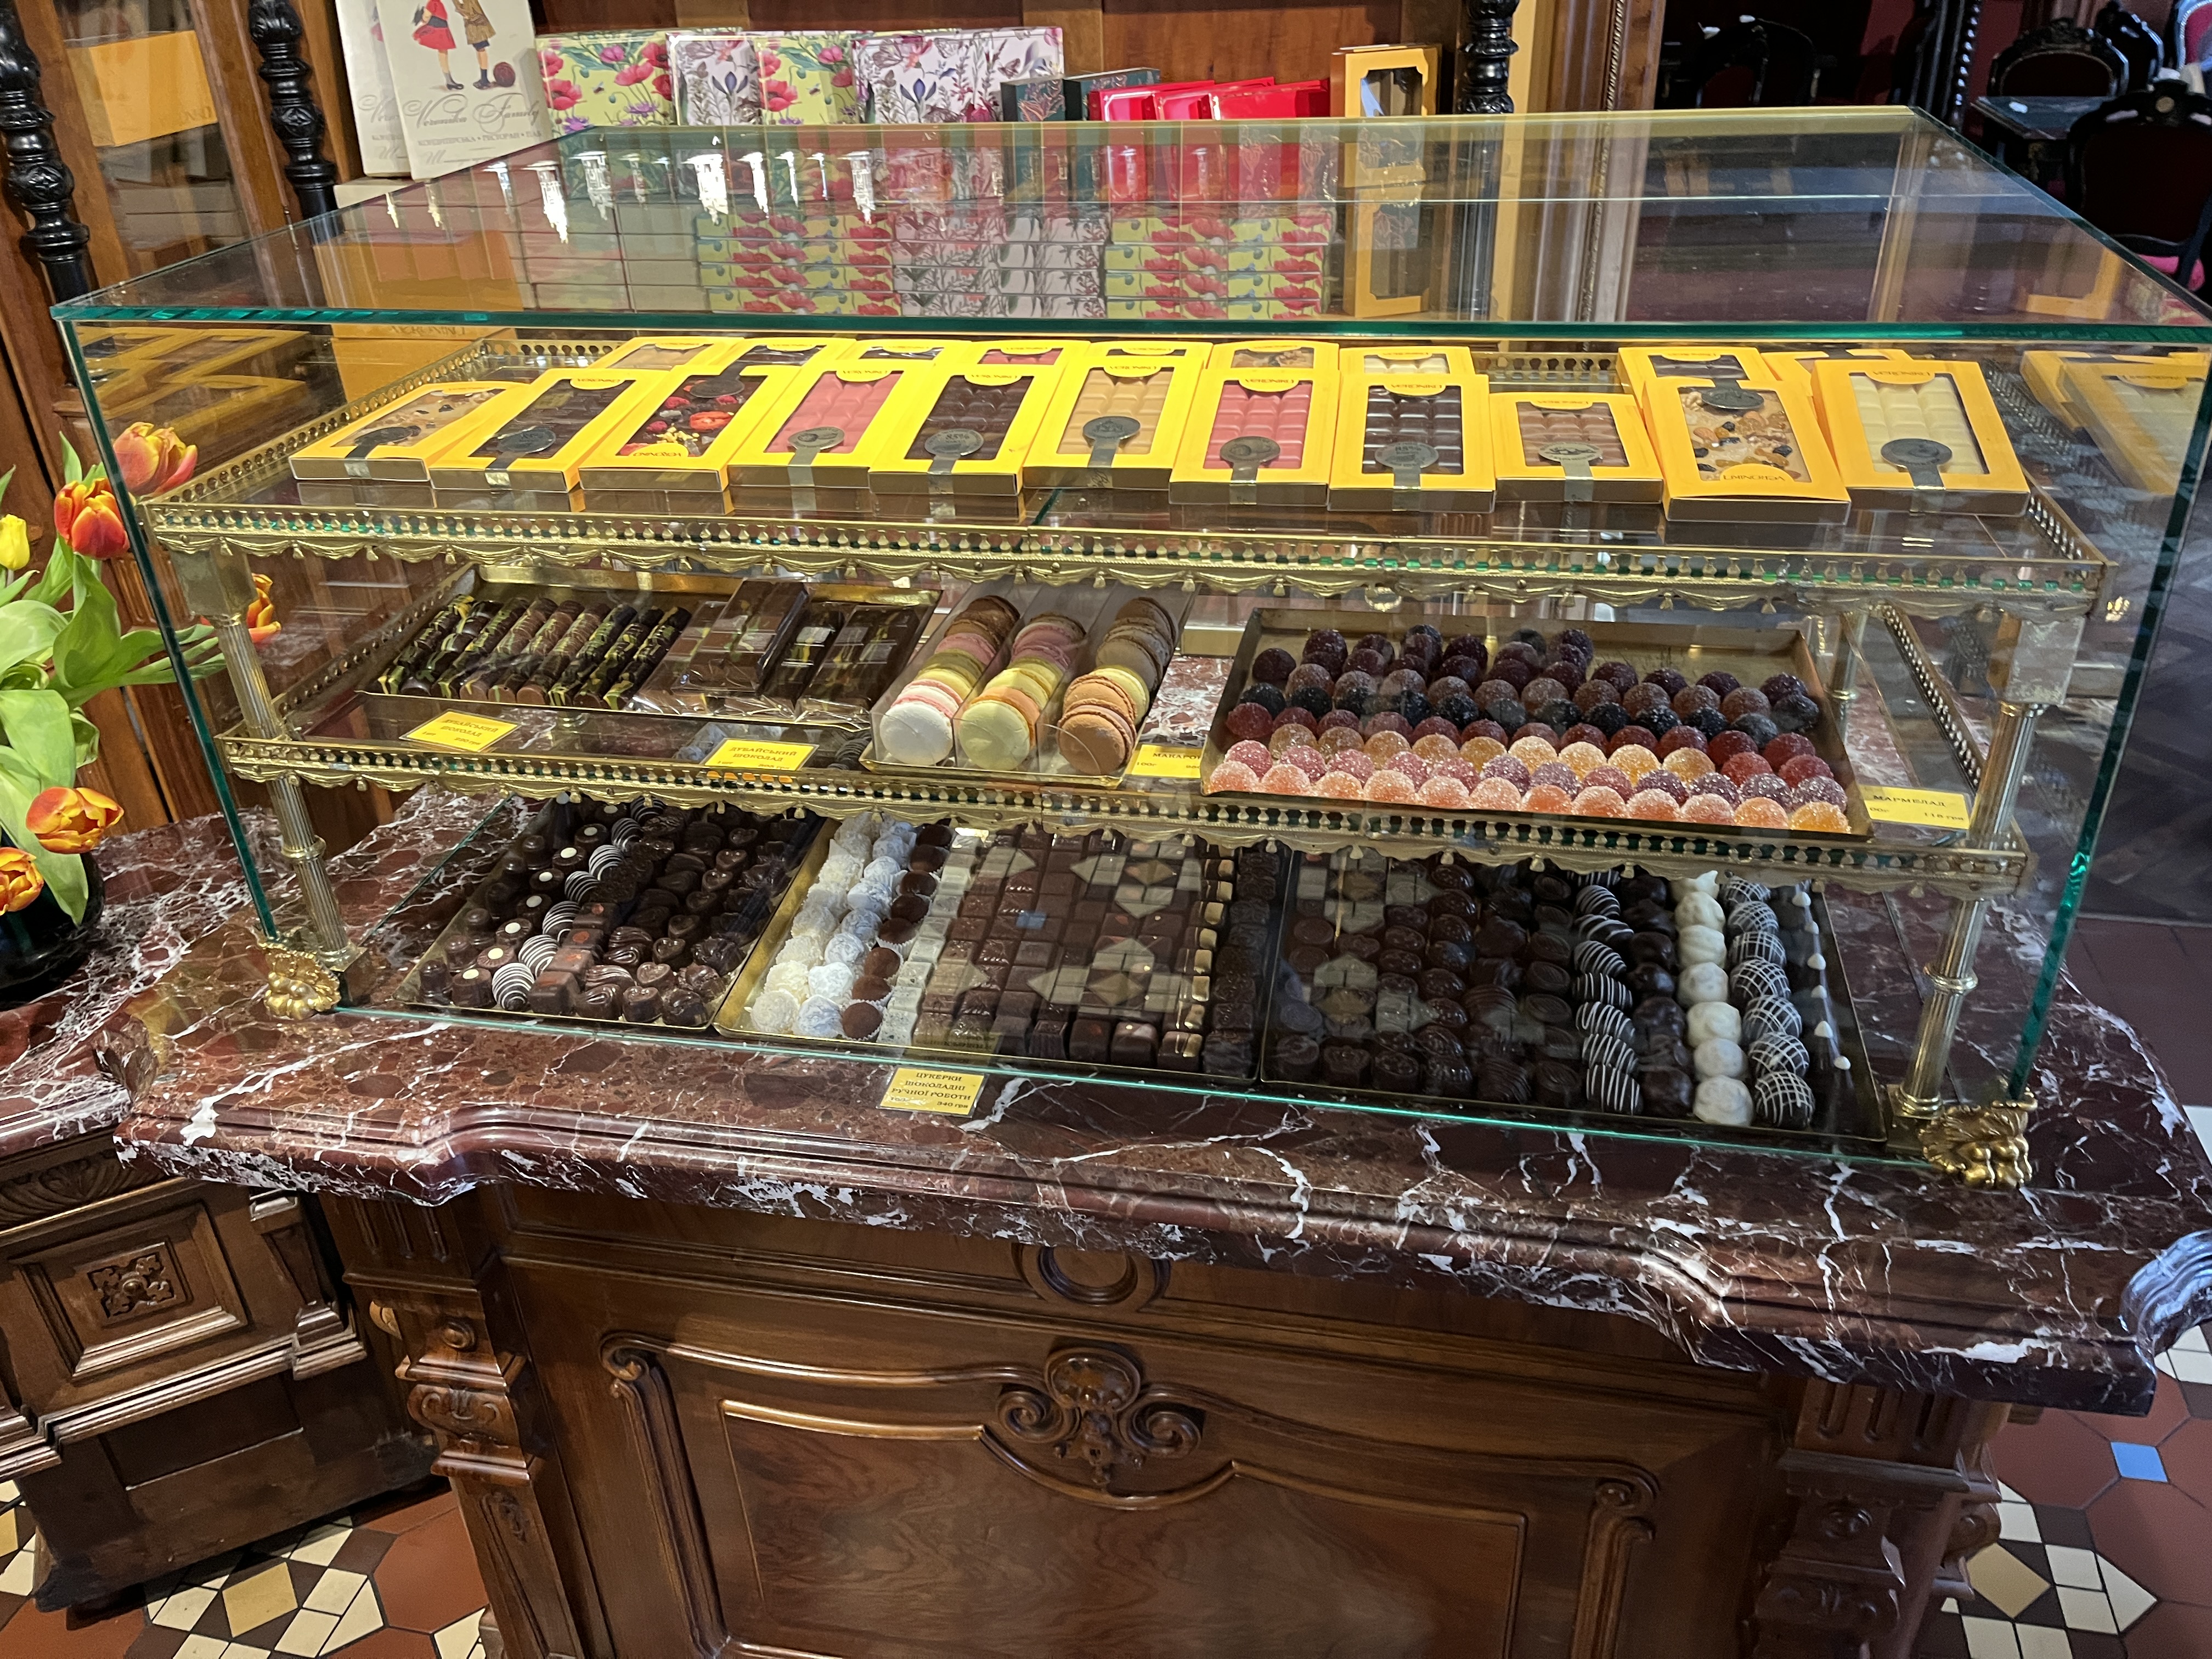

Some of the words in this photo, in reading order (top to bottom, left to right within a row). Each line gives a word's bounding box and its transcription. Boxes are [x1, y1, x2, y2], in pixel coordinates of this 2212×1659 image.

[729, 747, 797, 756] ДУБАЙСЬКИЙ
[732, 753, 783, 761] ШОКОЛАД
[1873, 795, 1946, 808] МАРМЕЛАД
[916, 1073, 962, 1081] ЦУКЕРКИ
[905, 1080, 966, 1091] ШОКОЛАДНІ
[891, 1088, 929, 1096] РУЧНОЇ
[930, 1092, 971, 1101] РОБОТИ
